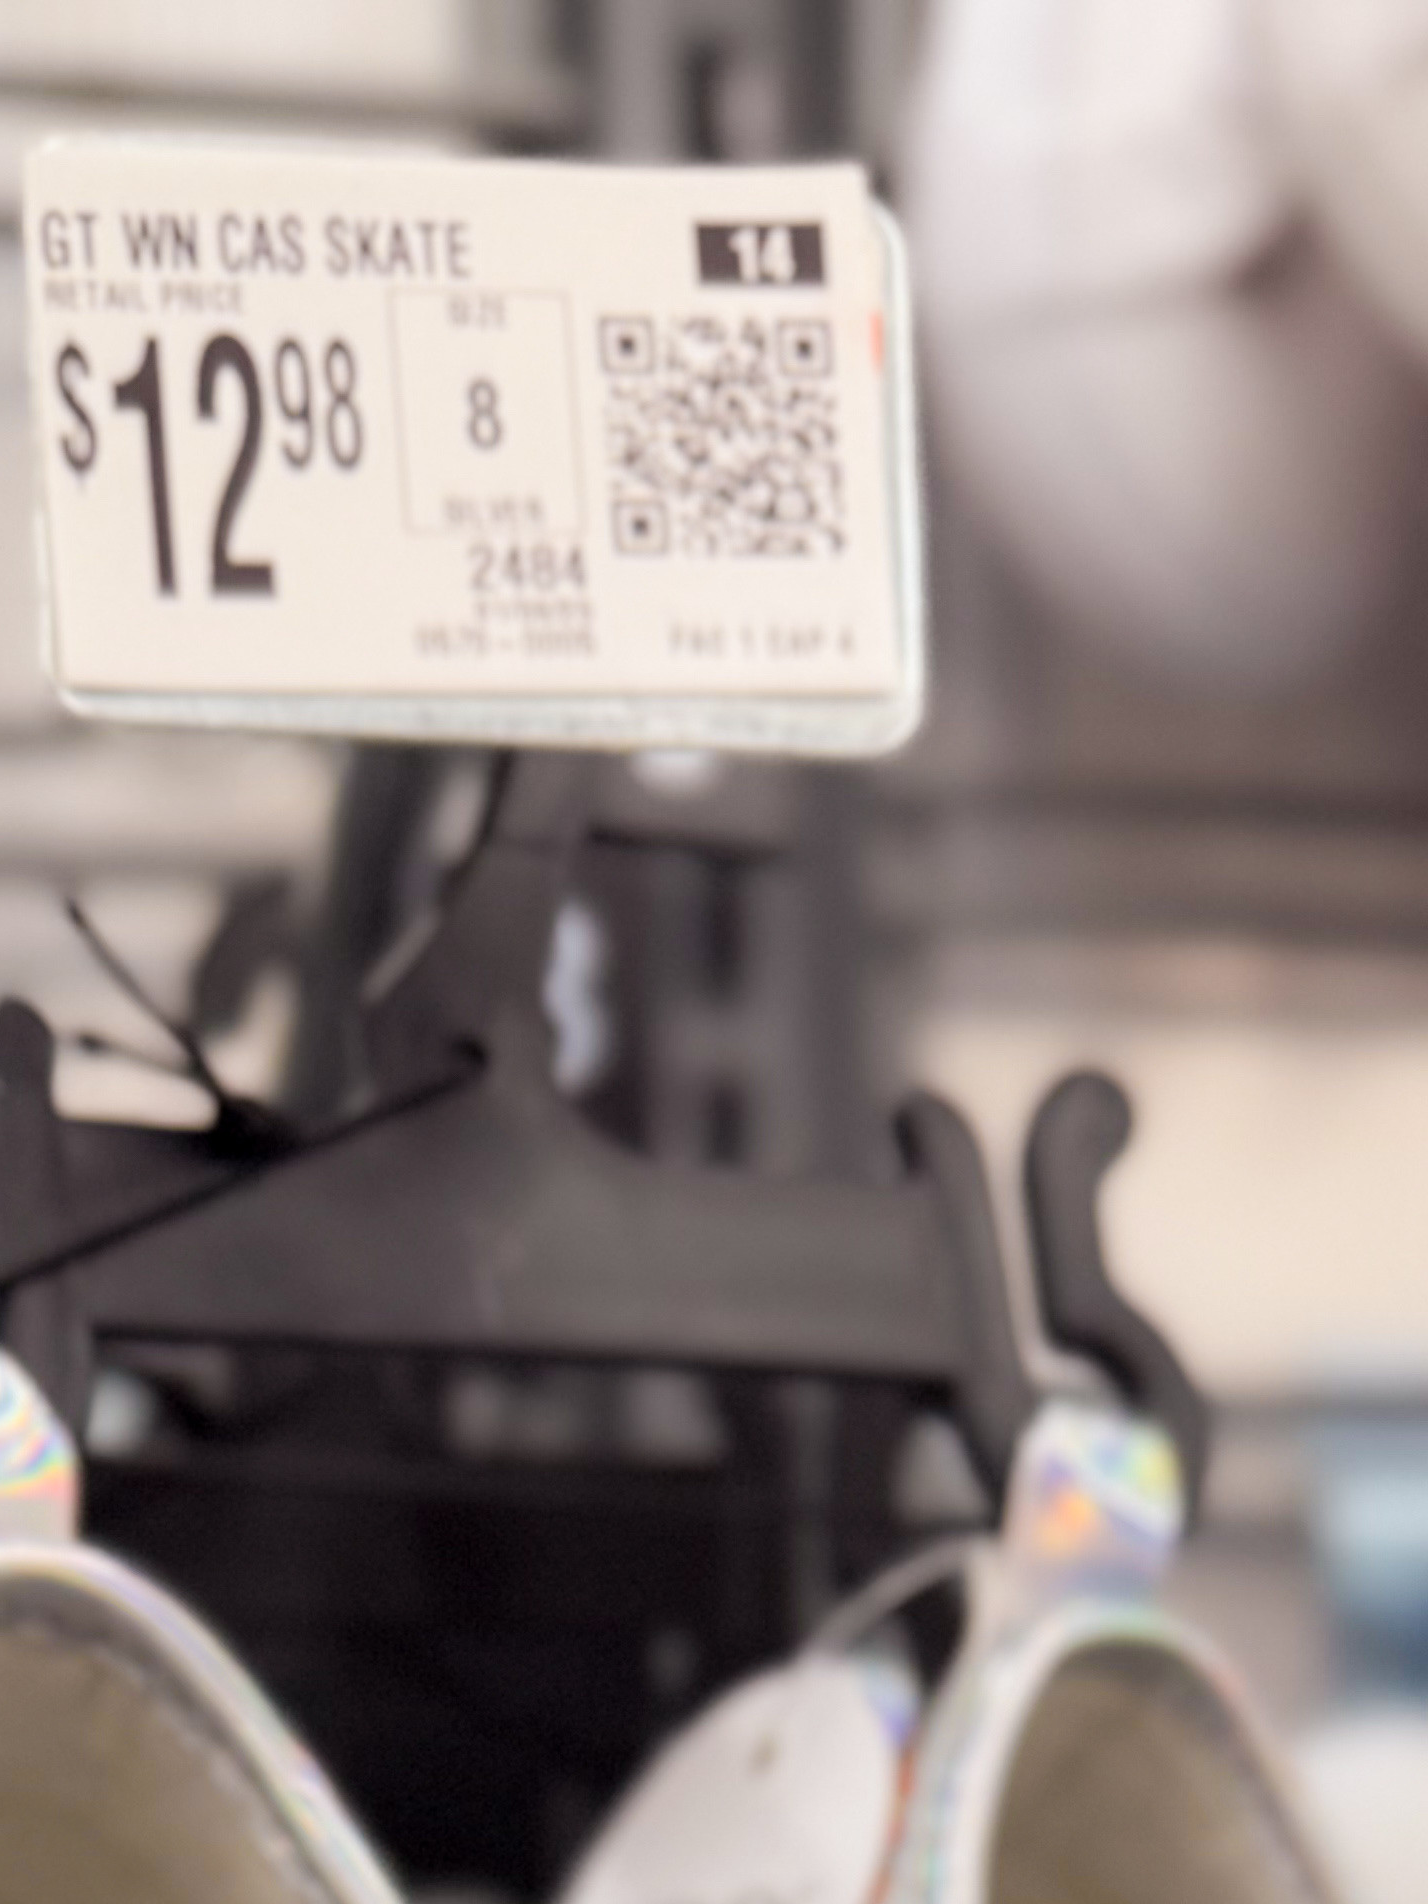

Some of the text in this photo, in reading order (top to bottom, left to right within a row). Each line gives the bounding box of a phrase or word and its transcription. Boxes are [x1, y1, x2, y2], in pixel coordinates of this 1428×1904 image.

[40, 208, 474, 280] GT WN CAS SKATE
[727, 226, 797, 285] 14
[44, 280, 246, 318] RETAIL PRICE
[466, 378, 503, 450] 8
[467, 543, 587, 592] 2484
